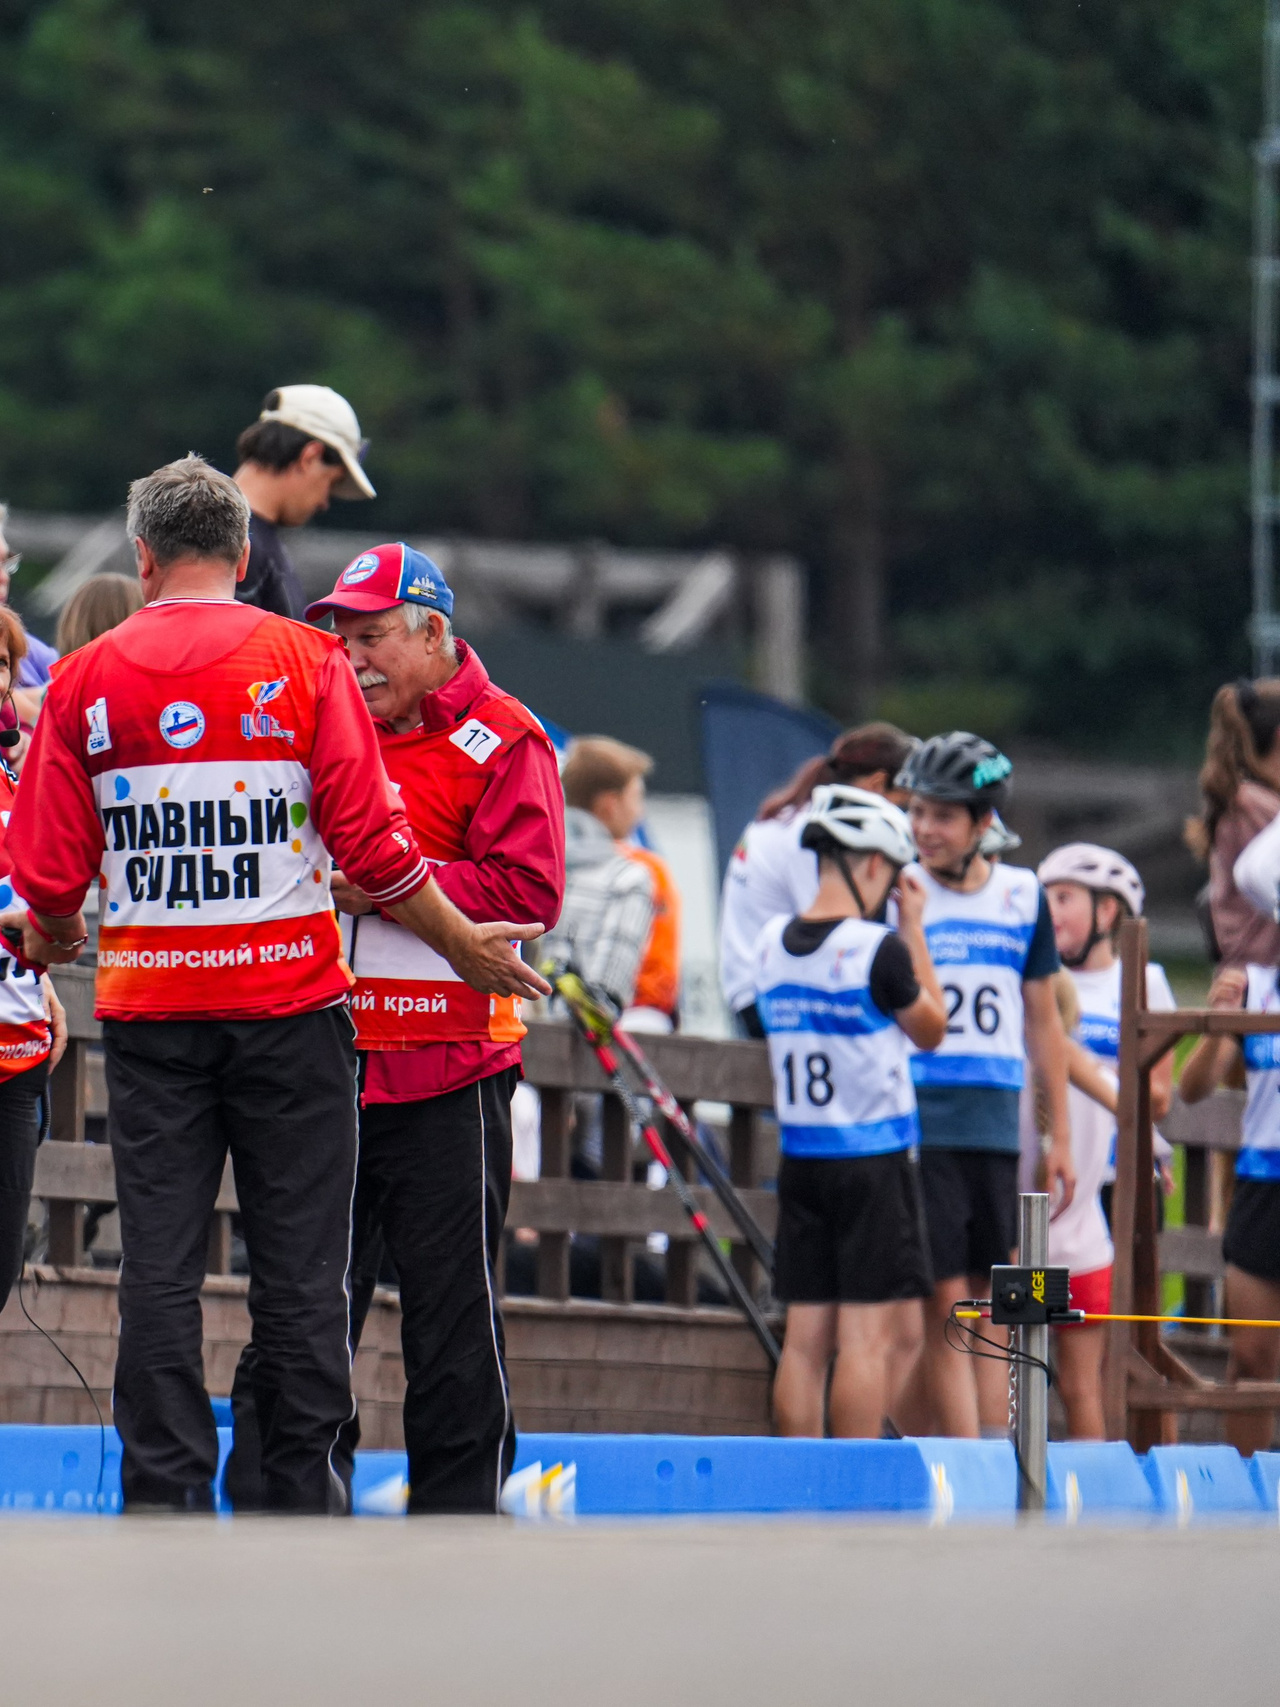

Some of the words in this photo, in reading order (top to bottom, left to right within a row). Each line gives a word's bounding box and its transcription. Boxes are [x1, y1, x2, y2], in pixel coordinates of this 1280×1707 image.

[464, 728, 490, 753] 17
[125, 852, 260, 909] СУДЬЯ
[259, 935, 314, 963] КРАЙ
[383, 993, 447, 1016] край
[942, 984, 1000, 1036] 26
[783, 1052, 834, 1107] 18
[1032, 1271, 1045, 1304] ALGE
